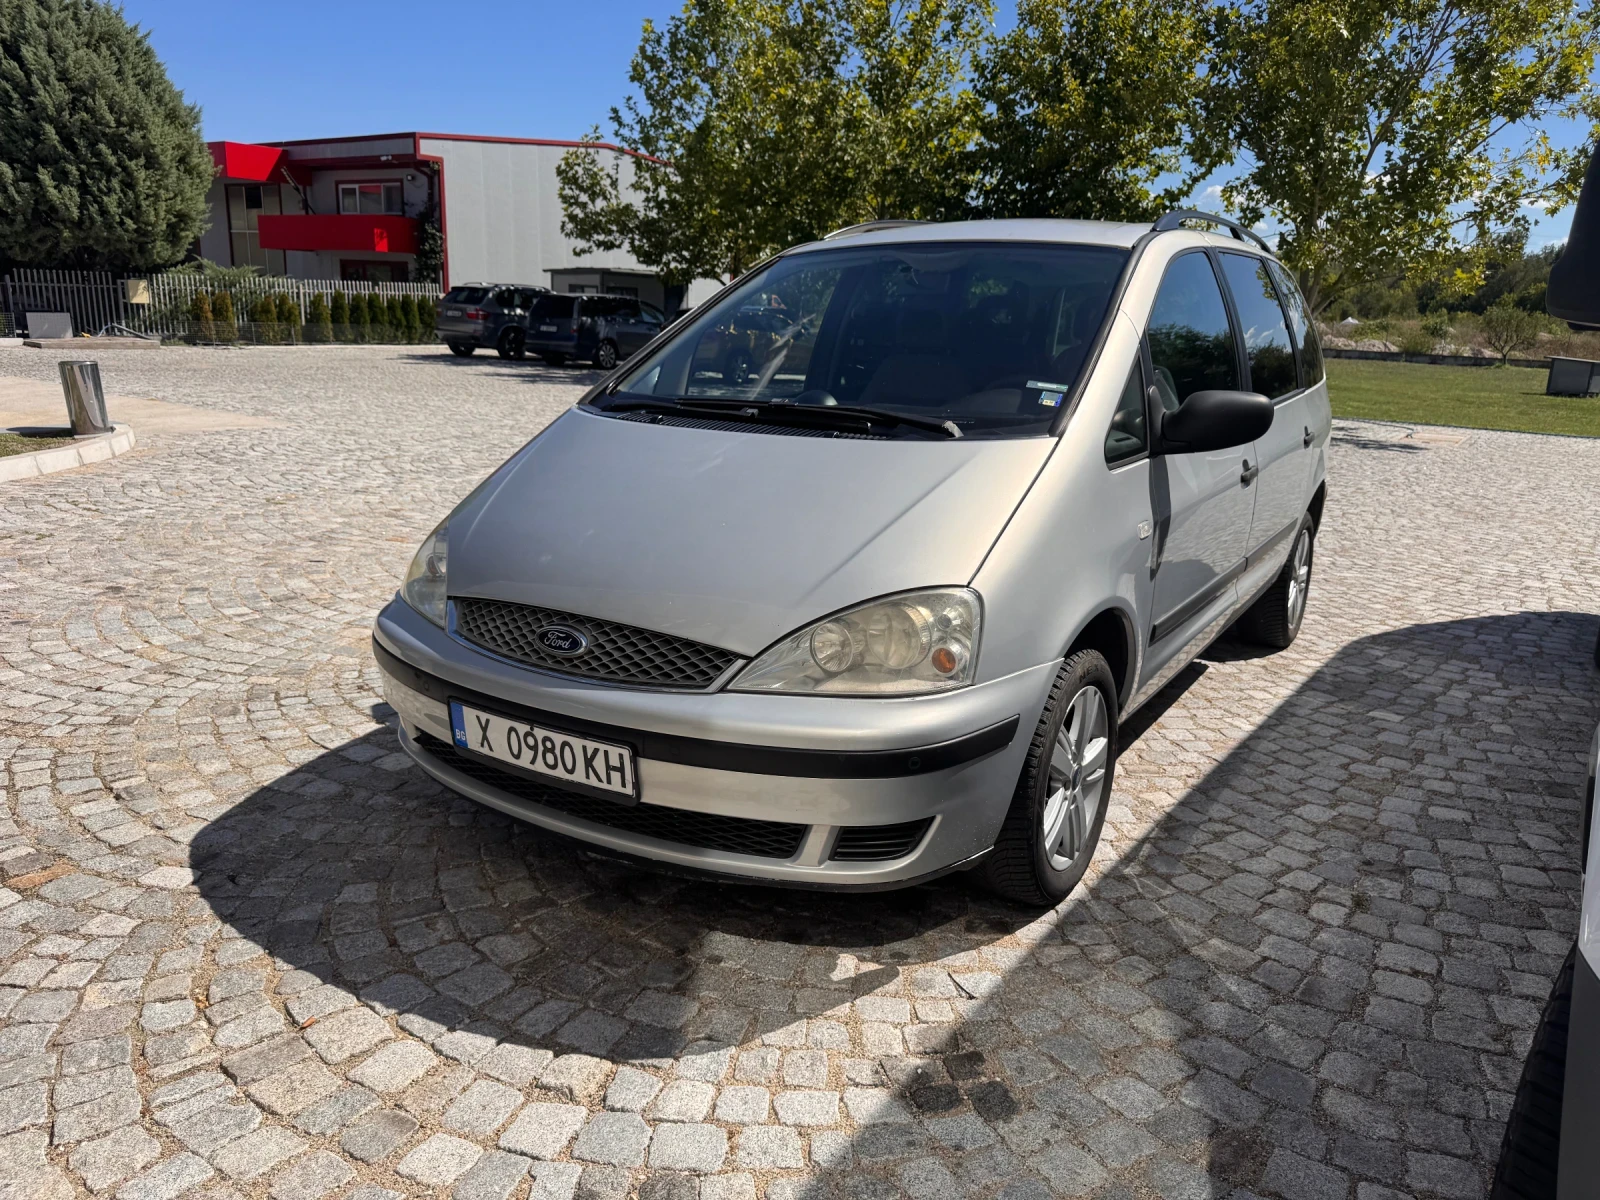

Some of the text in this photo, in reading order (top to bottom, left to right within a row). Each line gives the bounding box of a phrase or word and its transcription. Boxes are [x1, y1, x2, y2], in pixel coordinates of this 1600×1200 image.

[544, 631, 573, 649] Ford
[455, 728, 466, 741] BG
[507, 726, 577, 775] 0980
